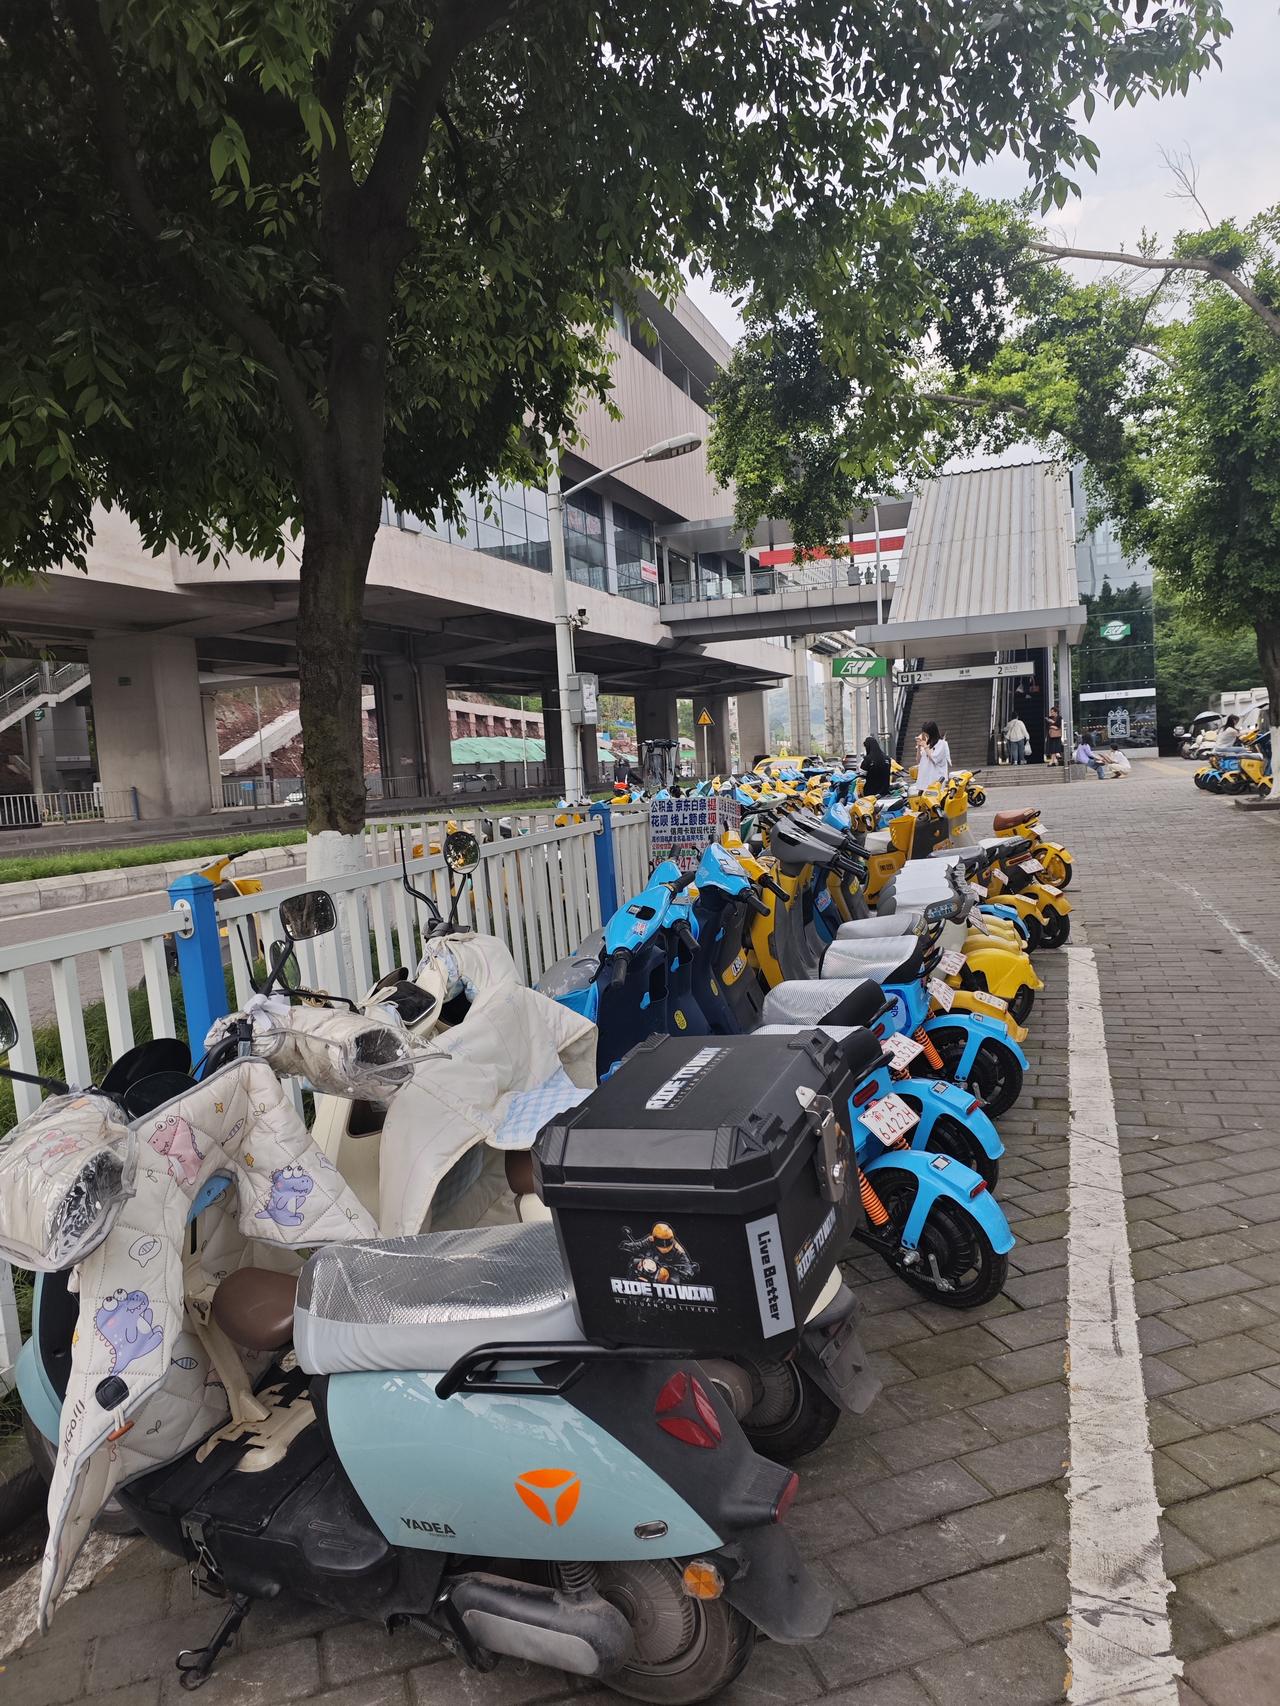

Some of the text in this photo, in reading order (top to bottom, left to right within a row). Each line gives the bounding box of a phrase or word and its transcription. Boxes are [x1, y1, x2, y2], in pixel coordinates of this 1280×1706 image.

[916, 674, 922, 682] 2
[997, 666, 1003, 675] 2
[651, 799, 707, 813] 公积金 京东白条
[651, 815, 668, 827] 花呗
[671, 813, 707, 826] 线上额度
[645, 1048, 722, 1110] RIDE TO WIN
[879, 1107, 916, 1141] 6422H
[796, 1242, 816, 1282] RIDE
[813, 1227, 825, 1253] TO
[822, 1206, 837, 1241] WIN
[757, 1230, 780, 1321] Live Better
[610, 1278, 715, 1303] RIDE TO WIN
[665, 1304, 716, 1313] DELIVERY
[400, 1517, 456, 1535] YADEA
